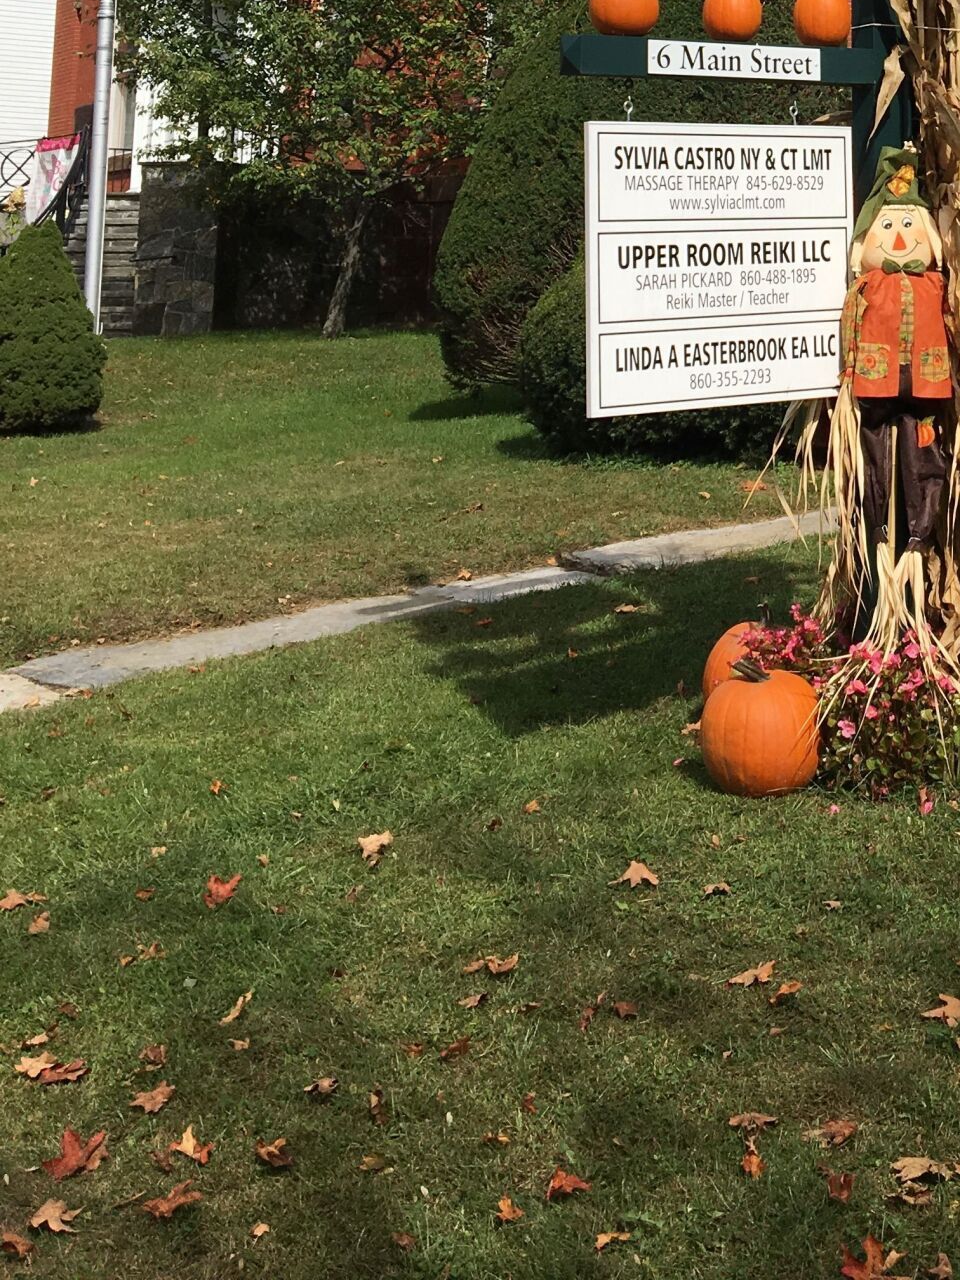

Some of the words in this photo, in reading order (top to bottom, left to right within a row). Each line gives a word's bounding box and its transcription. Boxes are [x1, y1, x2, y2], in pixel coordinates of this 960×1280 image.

[657, 45, 670, 68] 6
[681, 45, 741, 71] Main
[750, 49, 812, 74] Street
[615, 146, 669, 170] SYLVIA
[674, 147, 735, 170] CASTRO
[741, 148, 761, 169] NY
[765, 148, 775, 170] &
[781, 149, 798, 170] CT
[803, 149, 831, 170] LMT
[625, 175, 683, 191] MASSAGE
[688, 175, 739, 190] THERAPY
[746, 176, 824, 190] 845-629-8529
[670, 195, 785, 214] www.sylviaclmt.com
[618, 245, 680, 269] UPPER
[687, 243, 743, 266] ROOM
[751, 242, 796, 264] REIKI
[803, 240, 831, 262] LLC
[636, 273, 677, 291] SARAH
[681, 271, 732, 288] PICKARD
[740, 268, 816, 286] 860-488-1895
[666, 293, 694, 310] Reiki
[698, 293, 737, 308] Master
[739, 294, 744, 308] /
[749, 290, 789, 306] Teacher
[616, 346, 663, 372] LINDA
[668, 345, 678, 368] A
[684, 337, 787, 367] EASTERBROOK
[792, 336, 810, 359] EA
[814, 334, 836, 357] LLC
[690, 369, 771, 389] 860-355-2293
